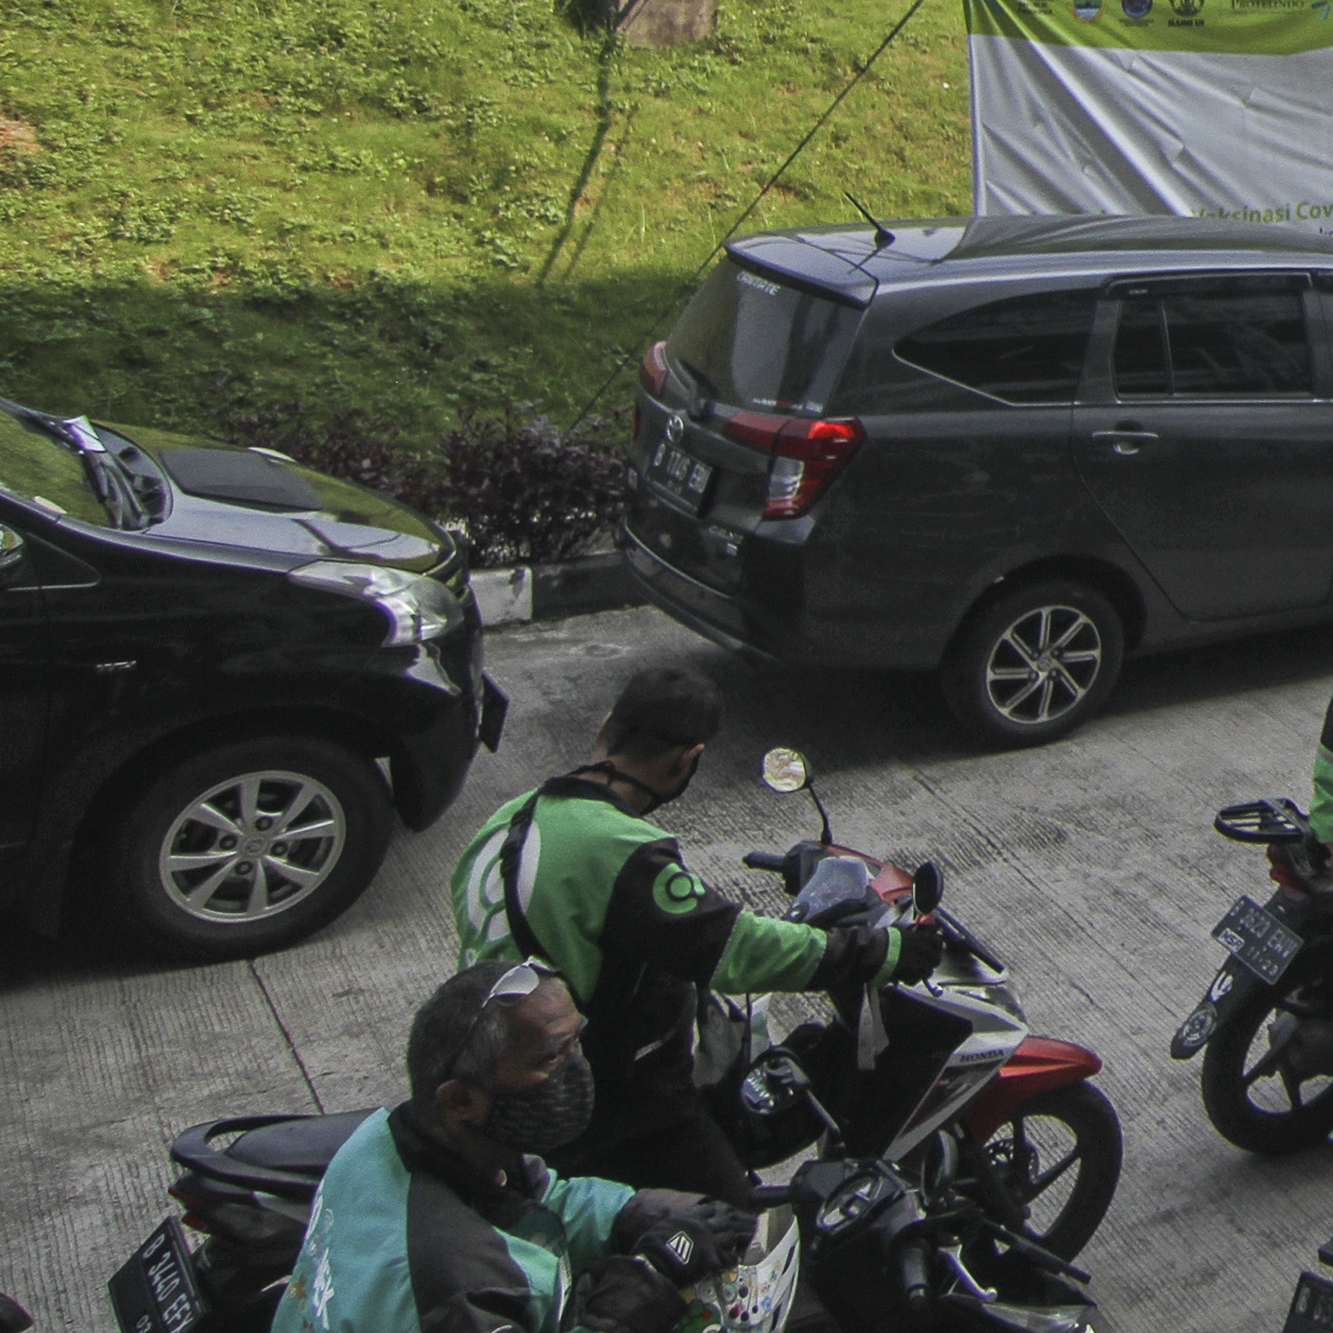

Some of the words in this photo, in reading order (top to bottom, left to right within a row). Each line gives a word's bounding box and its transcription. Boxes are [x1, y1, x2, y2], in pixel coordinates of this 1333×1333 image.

[960, 1048, 1004, 1064] HONDA
[143, 1233, 166, 1260] B
[148, 1251, 181, 1303] 3440
